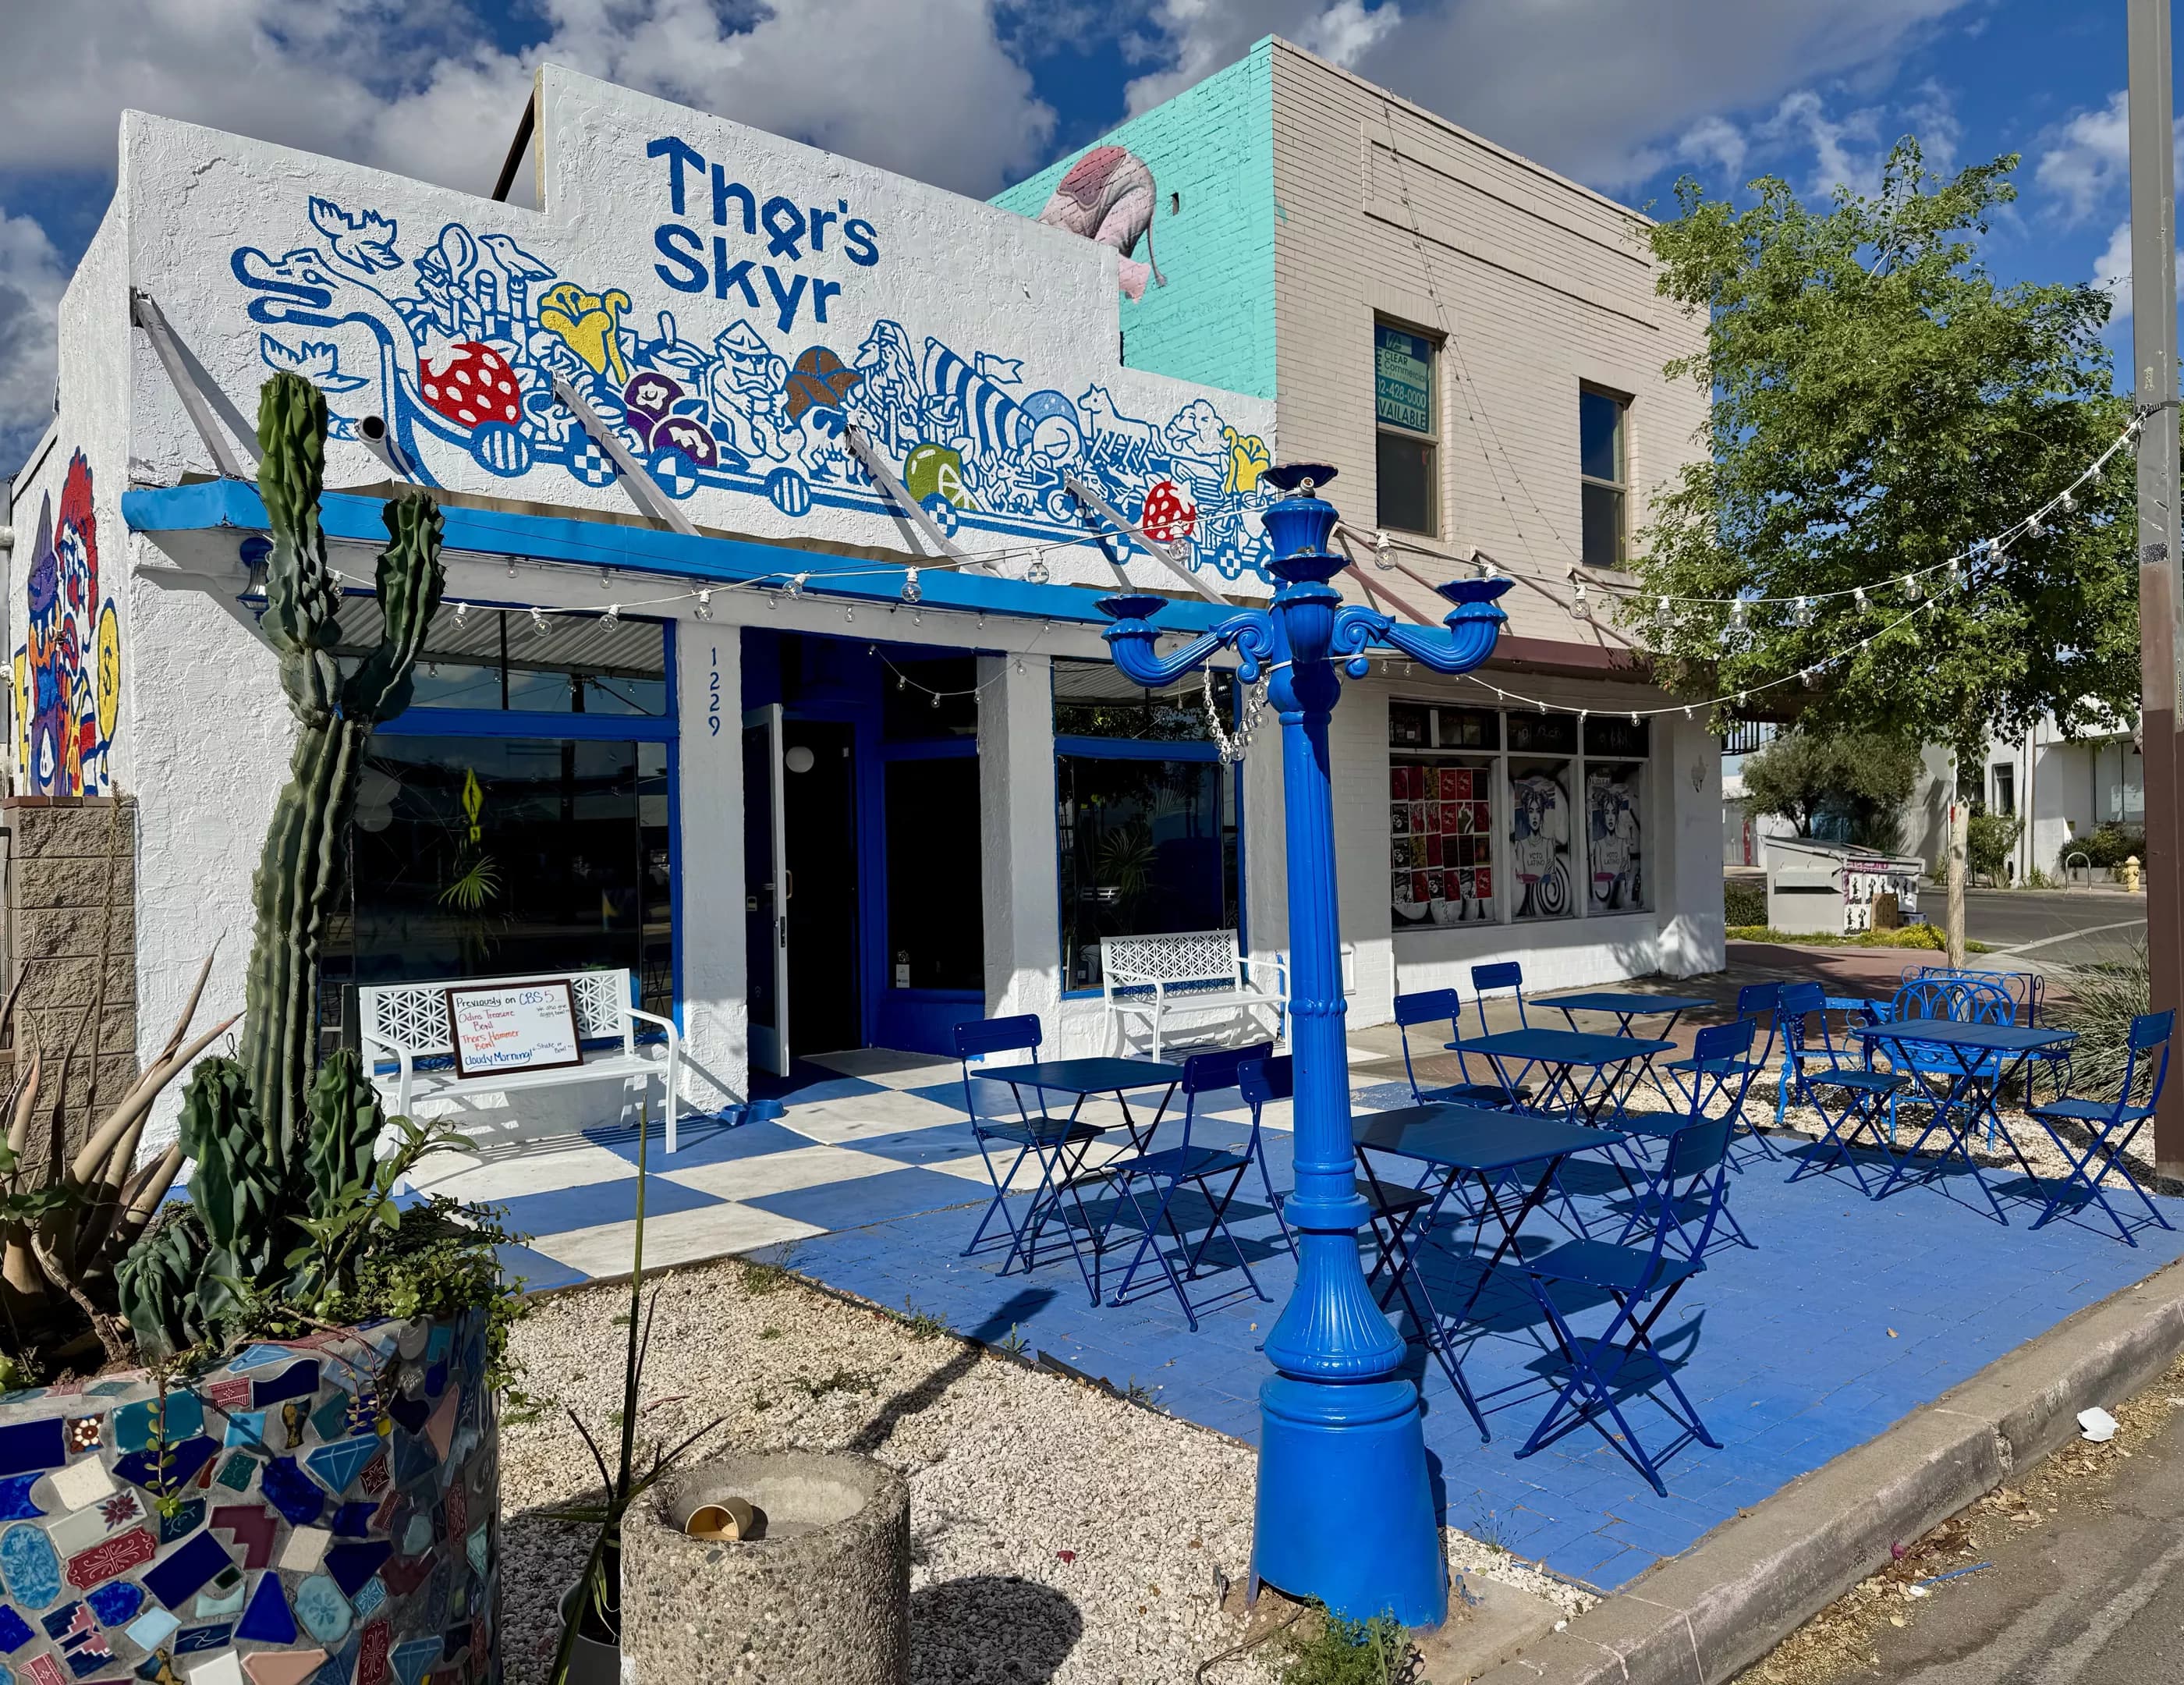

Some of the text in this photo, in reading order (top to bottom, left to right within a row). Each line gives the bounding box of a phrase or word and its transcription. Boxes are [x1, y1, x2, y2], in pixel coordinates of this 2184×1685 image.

[647, 137, 879, 266] Thor's
[654, 224, 842, 334] Skyr
[1384, 351, 1408, 367] CLEAR
[1384, 360, 1427, 382] Commercial
[708, 647, 720, 736] 1229
[456, 997, 502, 1008] Previously
[519, 991, 544, 1006] CBS
[458, 1009, 515, 1023] Odins Treasure
[460, 1031, 519, 1044] Thors Hammer
